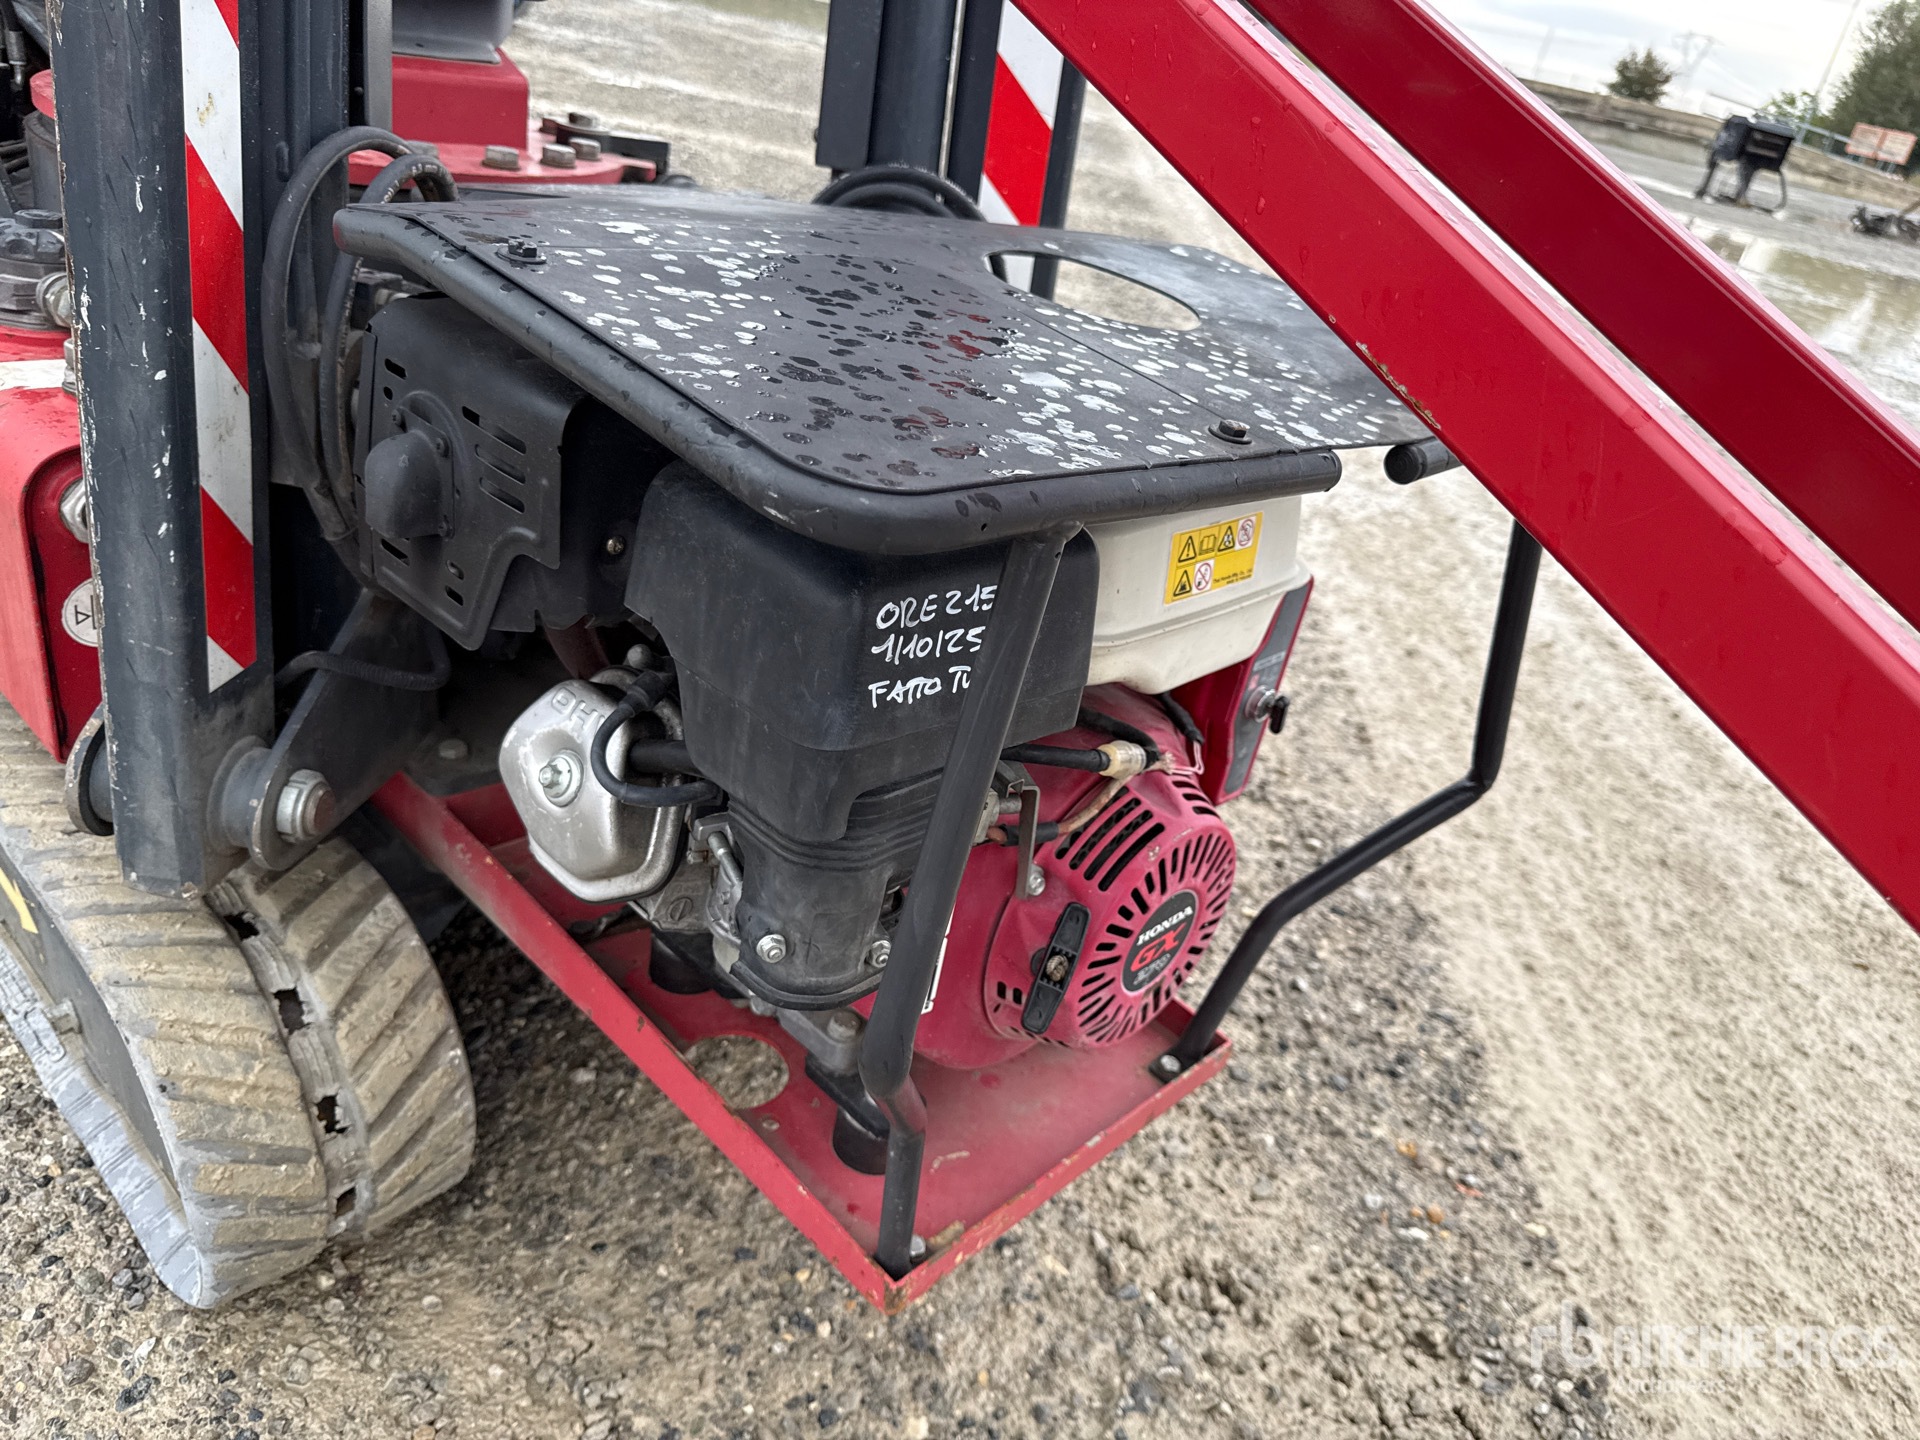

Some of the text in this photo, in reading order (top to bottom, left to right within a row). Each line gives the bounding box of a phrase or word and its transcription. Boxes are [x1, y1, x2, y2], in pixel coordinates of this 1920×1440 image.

[876, 584, 998, 629] ORE 215
[868, 677, 942, 708] FATTO
[1130, 922, 1187, 972] GX
[1137, 906, 1193, 946] HONDA
